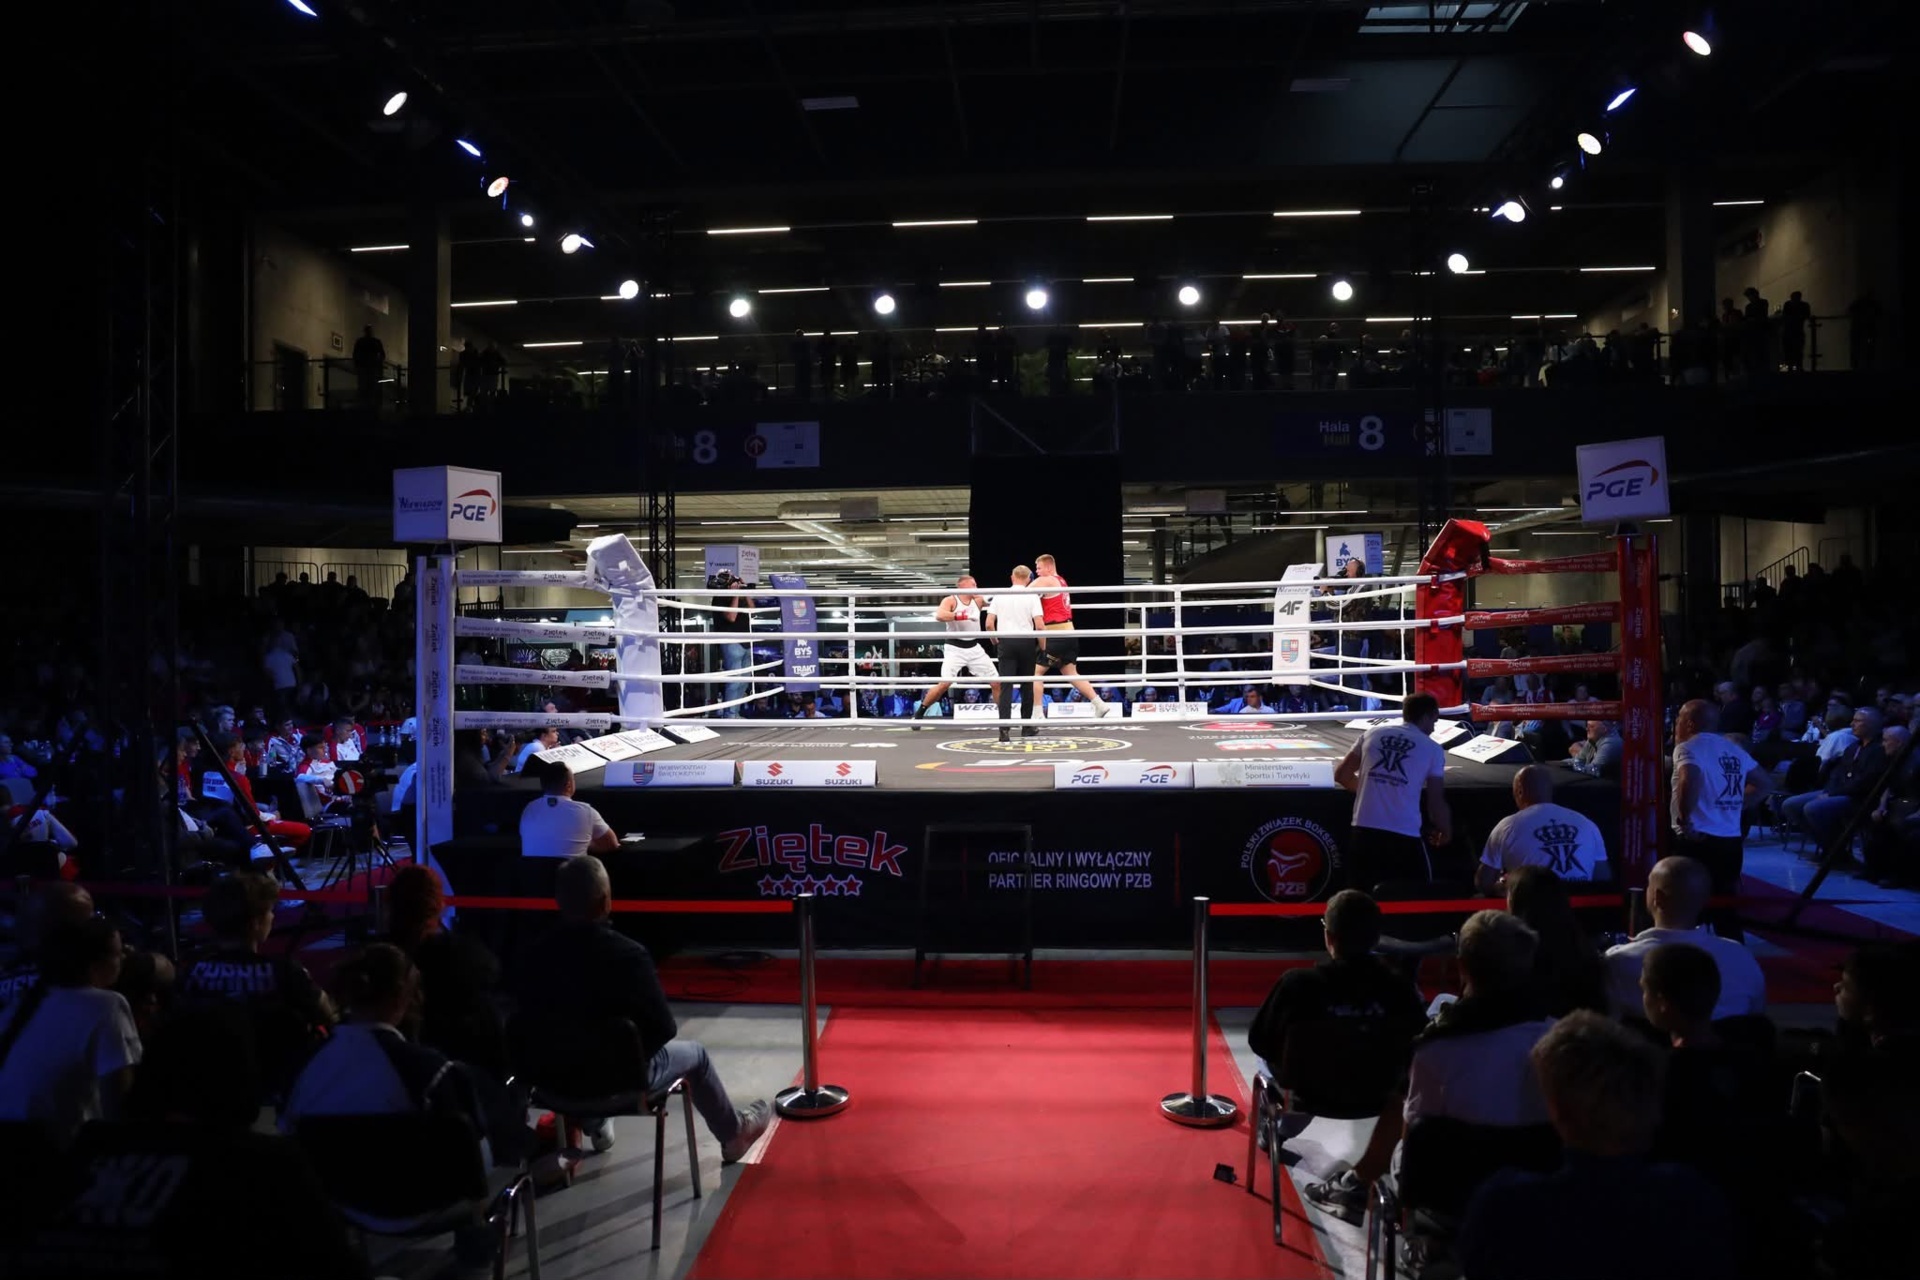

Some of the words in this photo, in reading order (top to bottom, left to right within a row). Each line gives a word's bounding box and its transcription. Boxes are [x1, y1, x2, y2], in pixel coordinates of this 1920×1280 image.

[1319, 420, 1351, 433] Hala
[1358, 415, 1385, 451] 8
[692, 429, 718, 465] 8
[1586, 477, 1645, 501] PGE
[450, 502, 487, 522] PGE
[1336, 557, 1358, 568] BY
[1279, 600, 1304, 616] 4F
[791, 664, 816, 676] TRAKT
[1244, 763, 1294, 772] Ministerstwo
[755, 778, 793, 786] SUZUKI
[824, 778, 863, 786] SUZUKI
[1071, 774, 1101, 784] PGE
[1139, 774, 1169, 784] PGE
[1276, 772, 1311, 781] Turystyki
[715, 823, 908, 877] Ziętek
[1240, 832, 1262, 869] POLSKI
[1074, 850, 1152, 871] WYŁĄCZNY
[1056, 872, 1122, 889] RINGOWY
[1125, 872, 1153, 889] PZB
[1274, 881, 1307, 896] PZB
